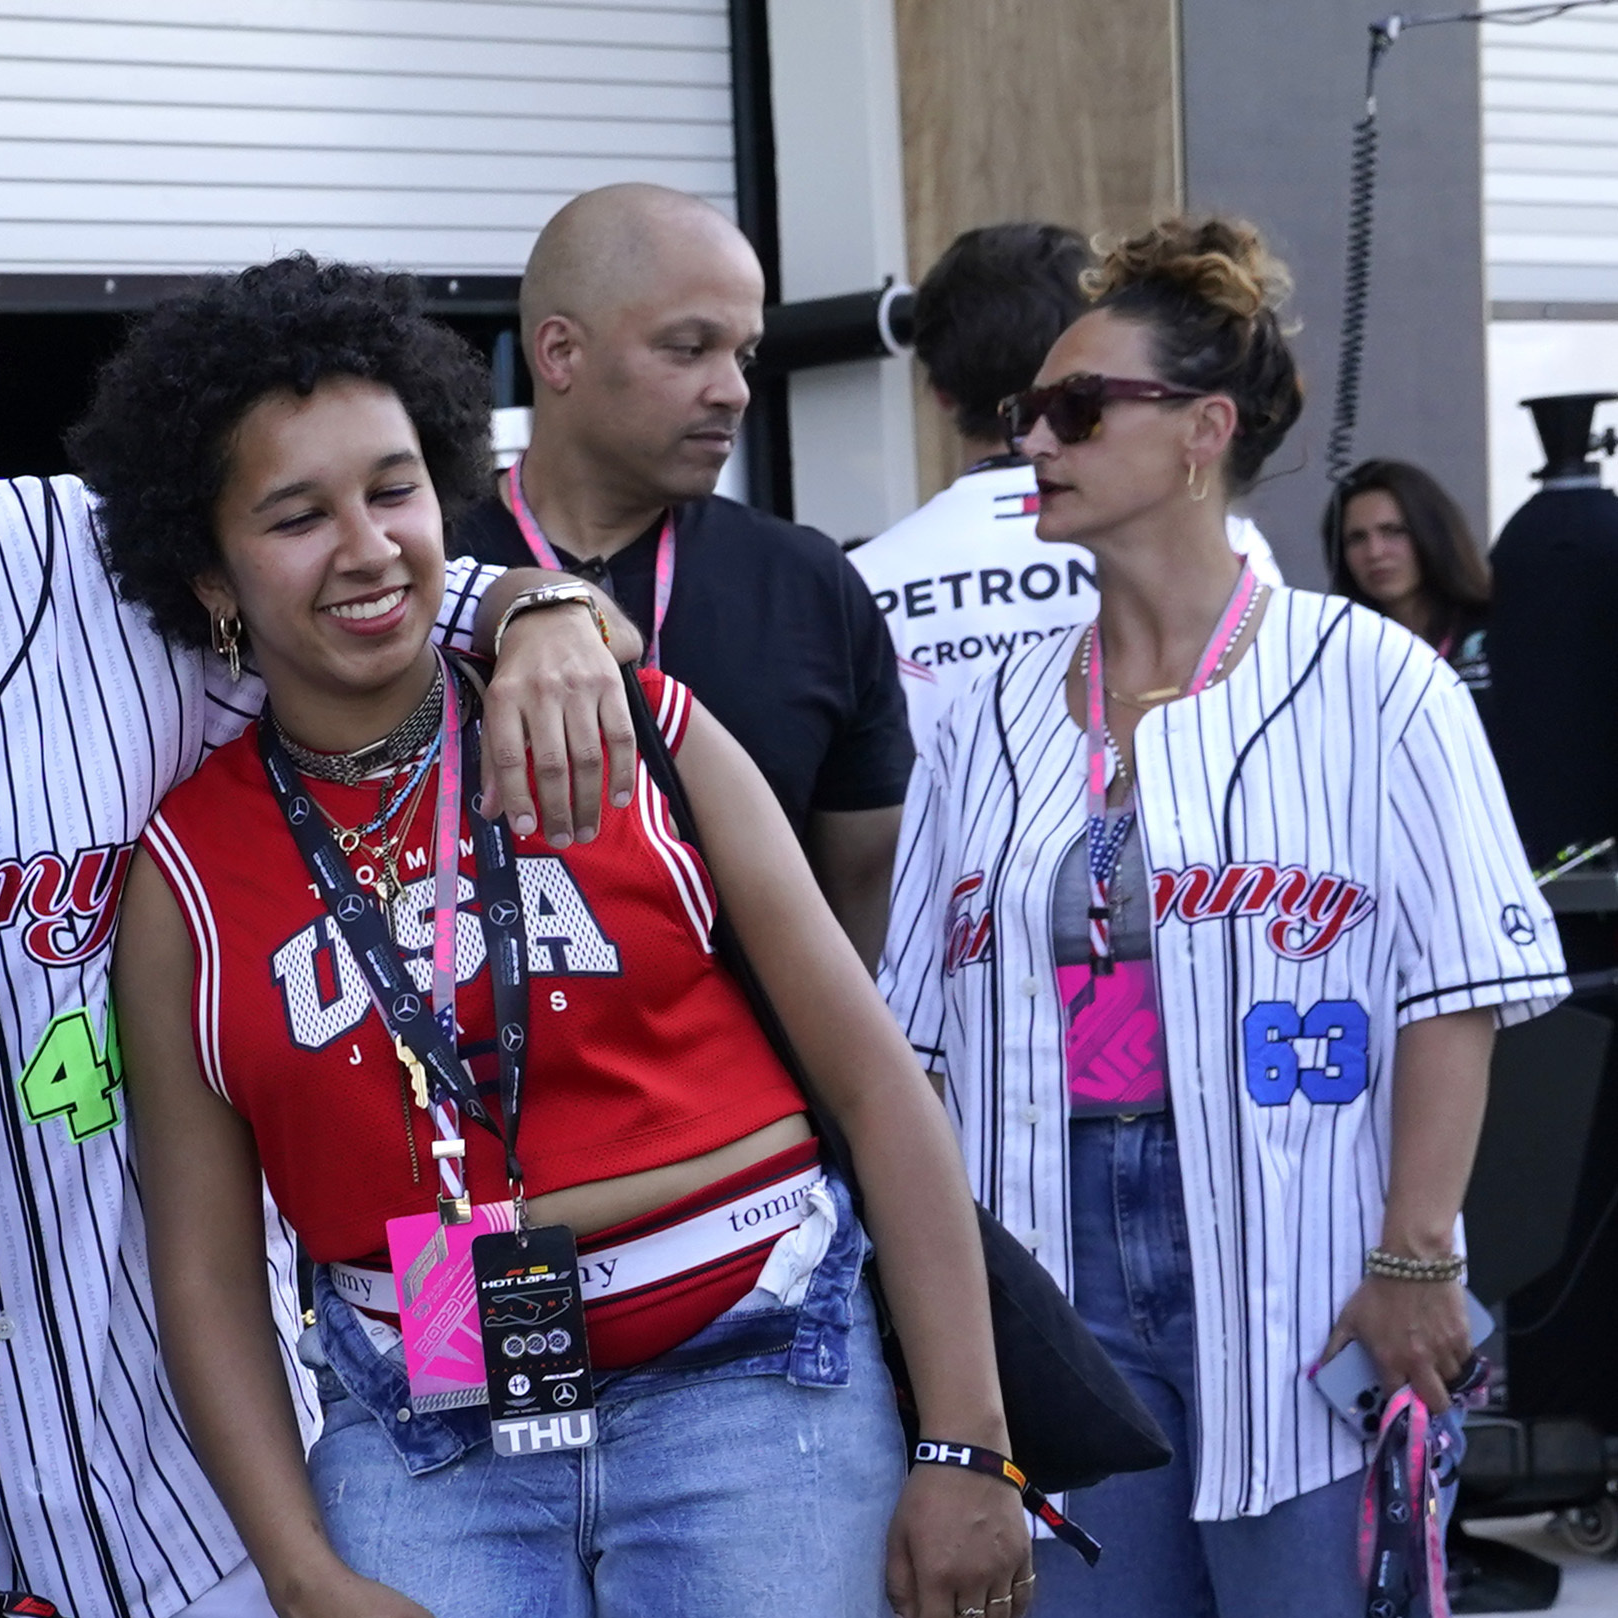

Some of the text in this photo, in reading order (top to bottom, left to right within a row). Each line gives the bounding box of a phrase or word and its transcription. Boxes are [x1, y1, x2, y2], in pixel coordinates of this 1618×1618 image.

[272, 853, 624, 1052] USA
[17, 985, 126, 1145] 4
[1243, 1000, 1371, 1108] 63
[482, 1278, 515, 1291] HOT
[498, 1413, 592, 1452] THU
